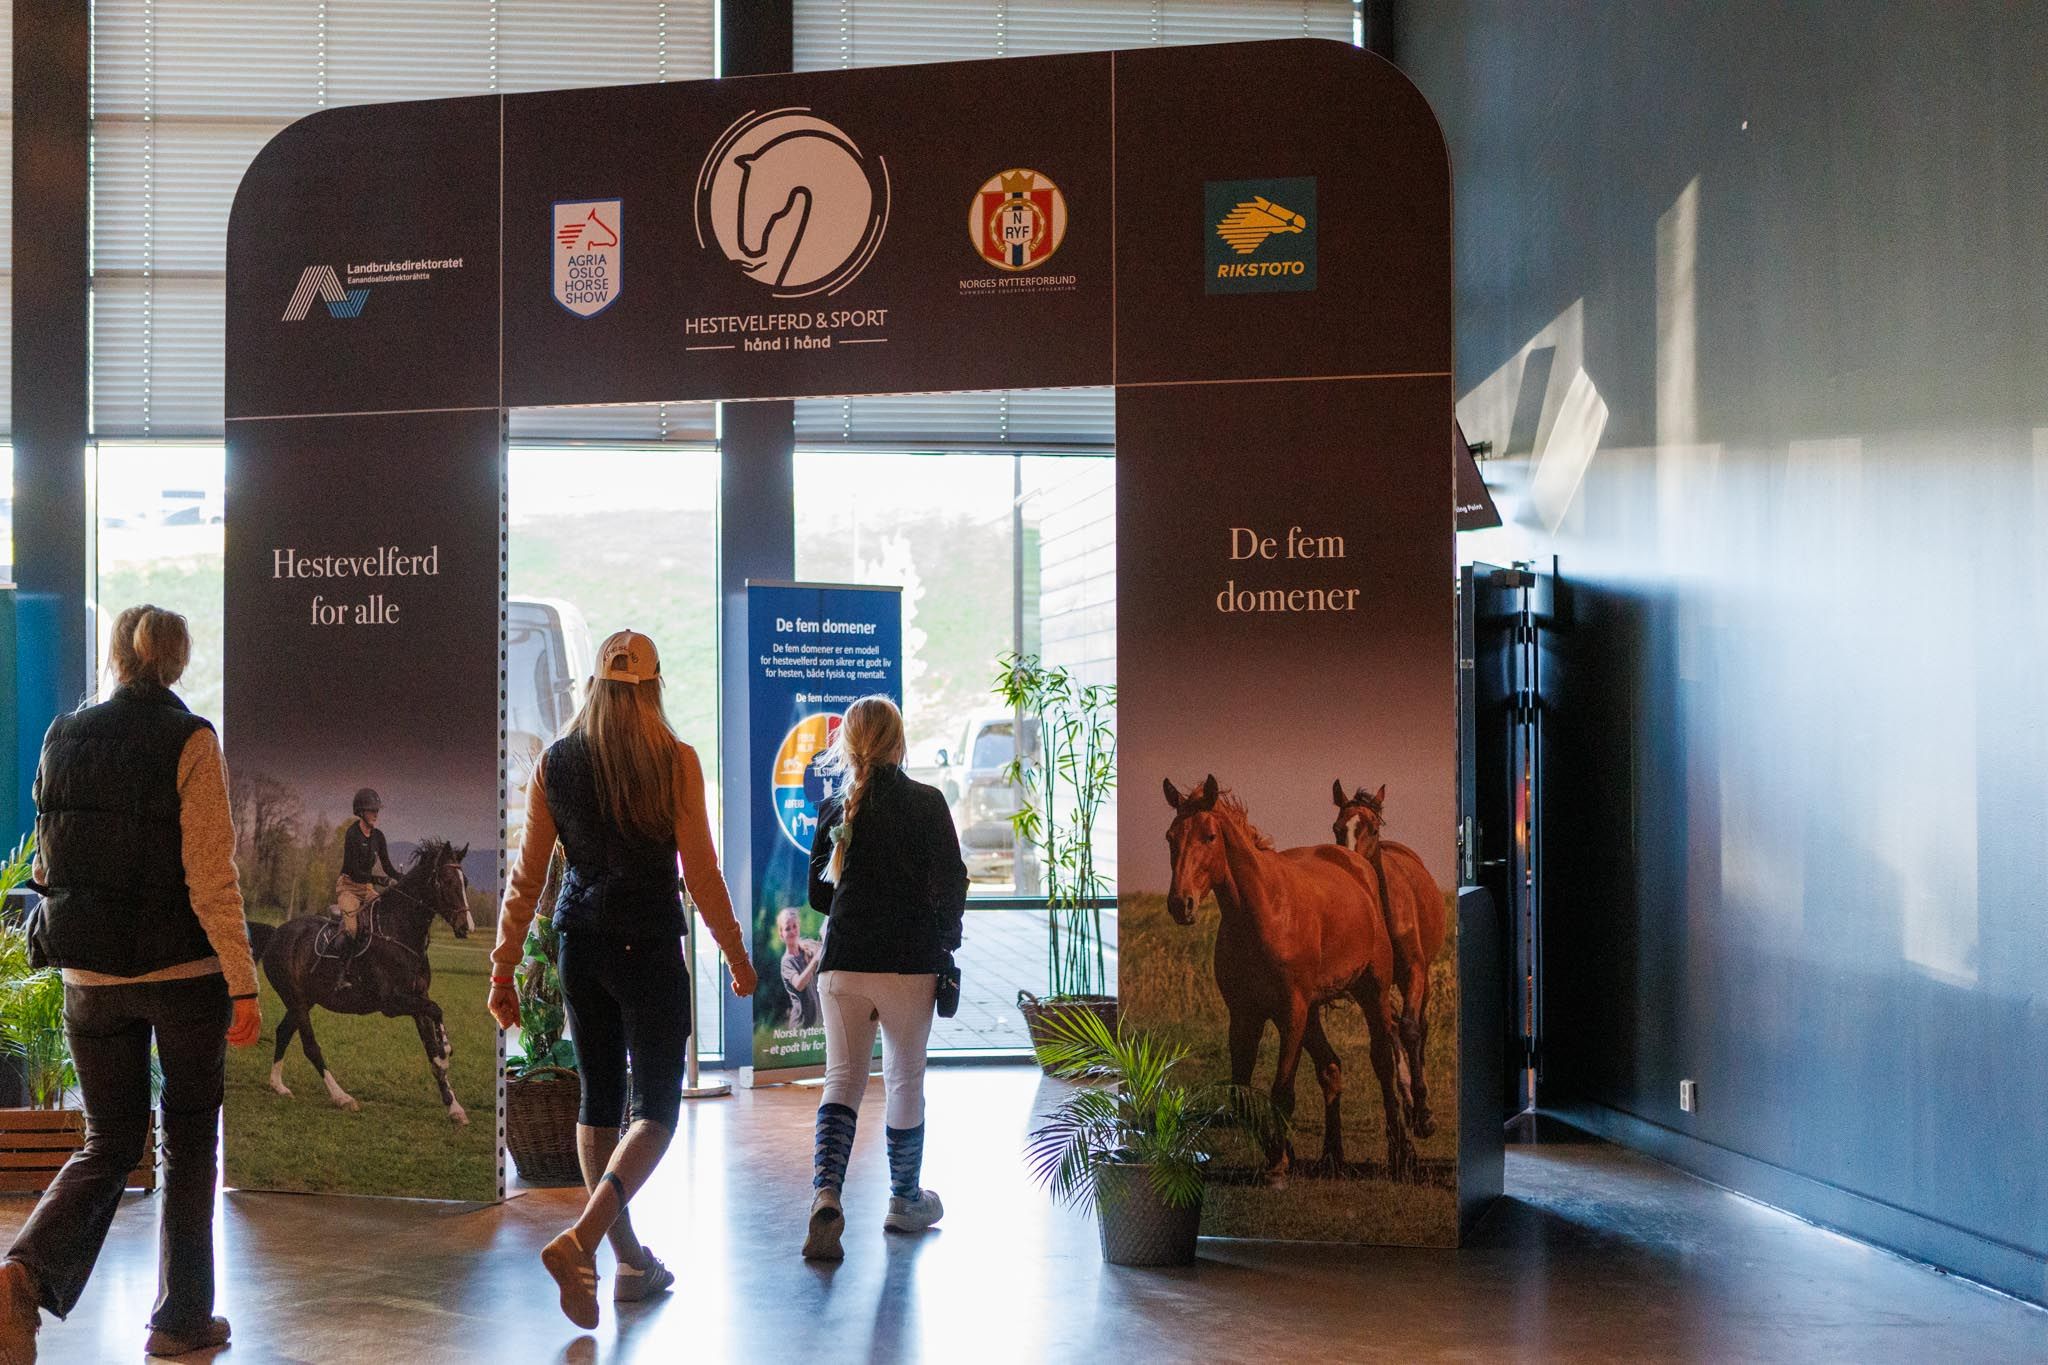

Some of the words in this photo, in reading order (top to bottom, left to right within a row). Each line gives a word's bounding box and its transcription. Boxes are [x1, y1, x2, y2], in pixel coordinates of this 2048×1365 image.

[1014, 212, 1022, 224] N
[1006, 226, 1030, 239] RYF
[348, 258, 463, 274] Landbruksdirektoratet
[568, 254, 607, 267] AGRIA
[569, 266, 605, 279] OSLO
[1217, 261, 1304, 278] RIKSTOTO
[565, 278, 608, 292] HORSE
[960, 278, 996, 288] NORGES
[998, 276, 1076, 287] RYTTERFORBUND
[566, 291, 608, 304] SHOW
[686, 313, 812, 334] HESTEVELFERD
[816, 312, 828, 328] &
[830, 310, 888, 328] SPORT
[744, 338, 780, 351] hånd
[785, 337, 789, 350] i
[794, 336, 830, 350] hånd
[1229, 528, 1277, 559] De
[1286, 526, 1346, 558] fem
[272, 545, 439, 578] Hestevelferd
[1216, 580, 1360, 612] domener
[310, 595, 348, 625] for
[355, 594, 399, 624] alle
[776, 618, 793, 632] De
[796, 618, 819, 633] fem
[822, 619, 876, 634] domener
[773, 644, 783, 652] De
[785, 644, 799, 653] fem
[801, 644, 833, 654] domener
[855, 646, 879, 654] modell
[760, 656, 771, 665] for
[773, 656, 817, 666] hestevelferd
[819, 658, 834, 666] som
[836, 658, 855, 666] sikrer
[866, 658, 881, 668] godt
[883, 658, 891, 667] liv
[766, 668, 776, 678] for
[778, 669, 805, 679] hesten,
[806, 668, 824, 678] både
[826, 670, 845, 679] fysisk
[847, 671, 856, 680] og
[857, 670, 886, 679] mentalt.
[796, 693, 806, 702] De
[808, 693, 822, 702] fem
[773, 1029, 798, 1039] Norsk
[770, 1046, 779, 1054] et
[780, 1044, 800, 1056] godt
[801, 1042, 812, 1051] liv
[813, 1041, 825, 1050] for
